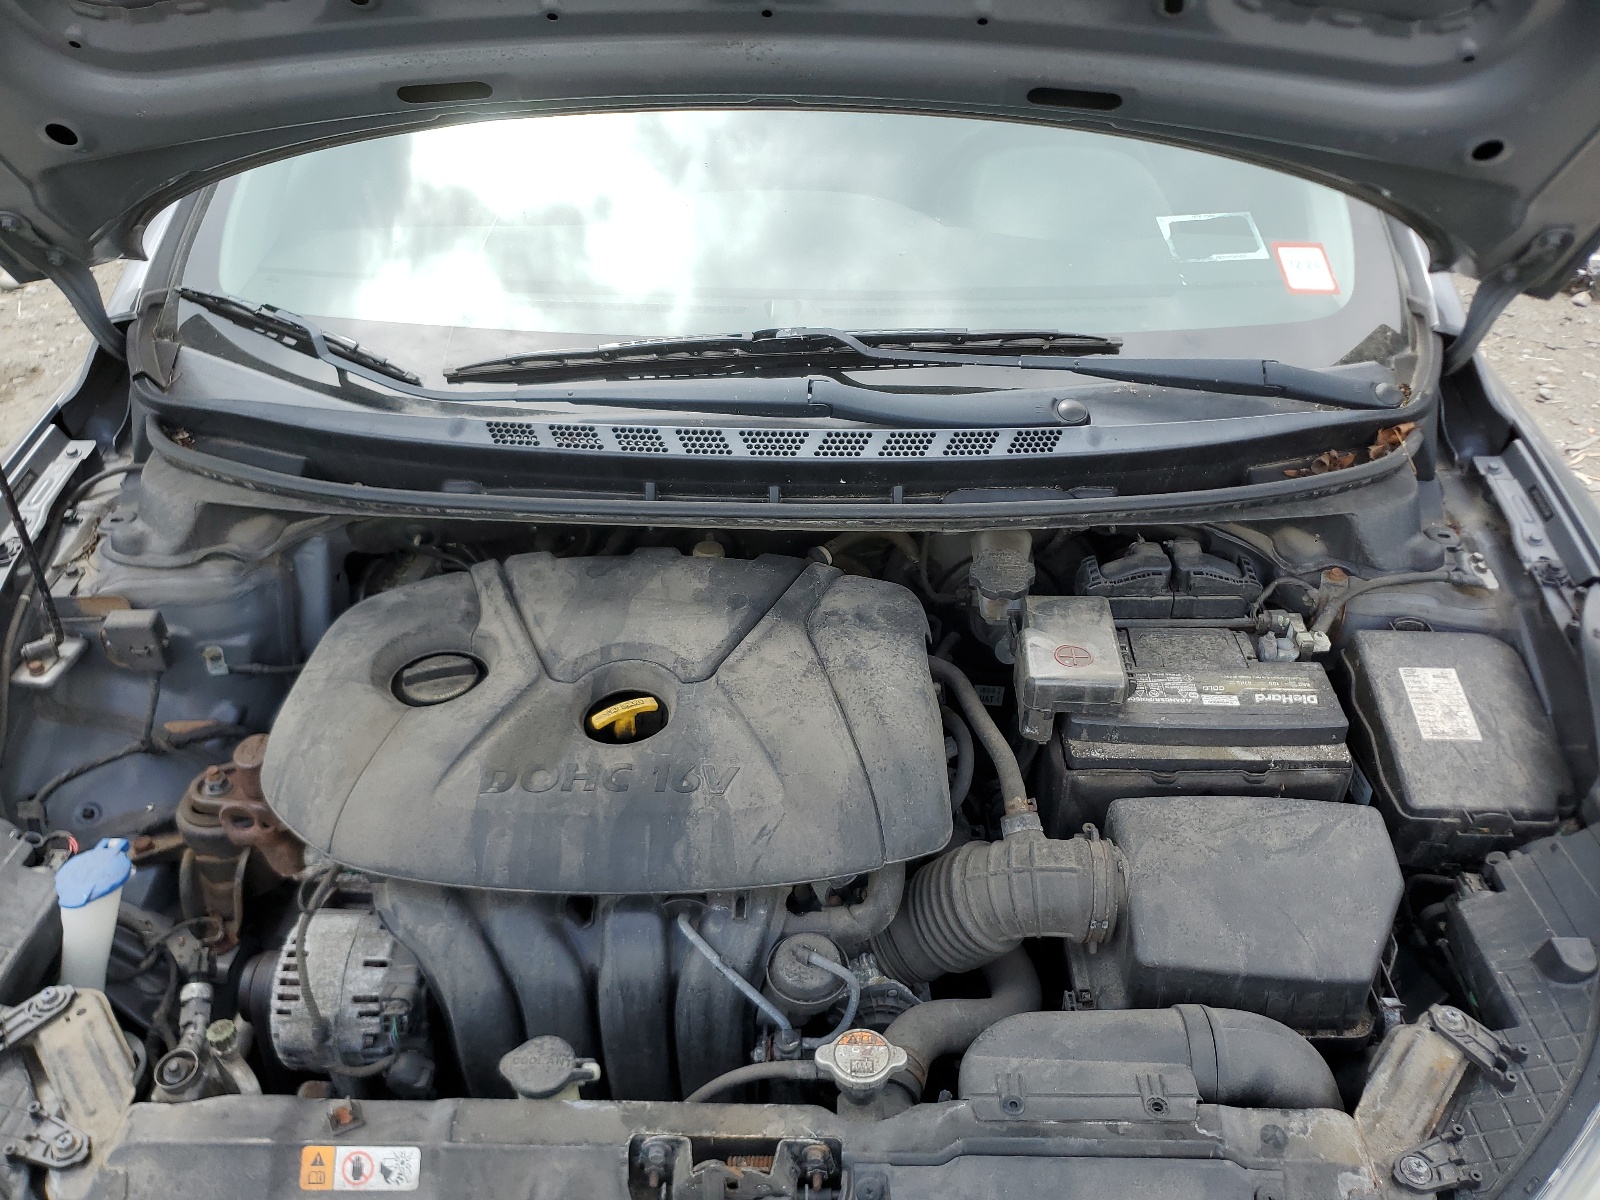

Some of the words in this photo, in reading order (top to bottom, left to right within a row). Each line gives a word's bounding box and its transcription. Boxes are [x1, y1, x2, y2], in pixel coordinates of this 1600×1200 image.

[1254, 693, 1318, 705] DieHard
[478, 763, 633, 794] DOHC
[652, 763, 740, 794] 16V
